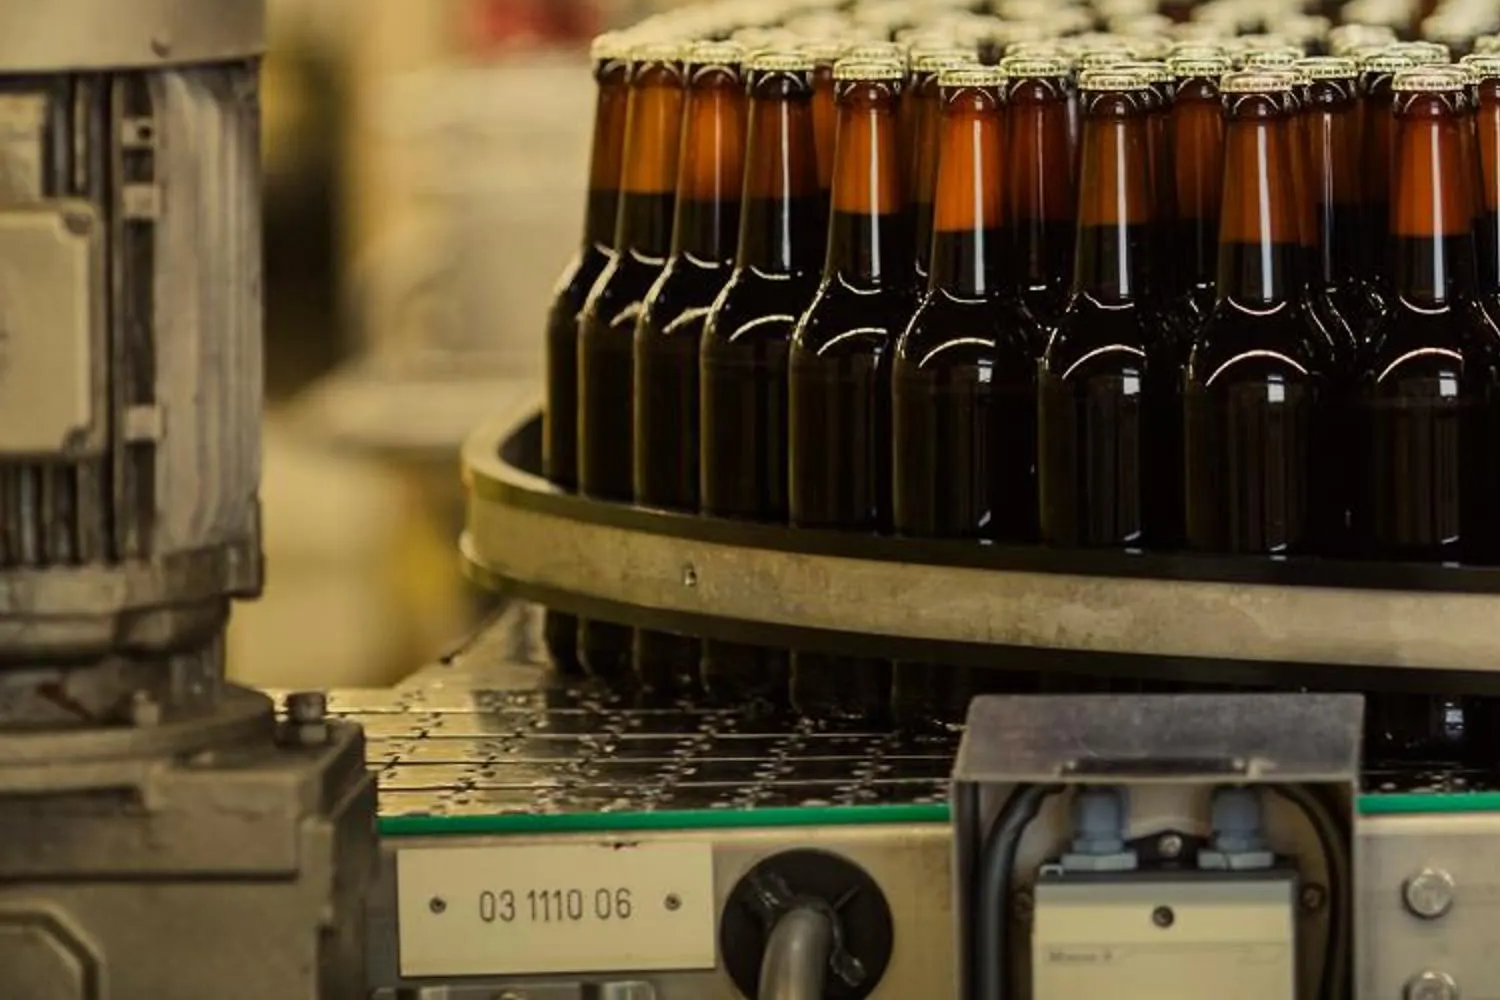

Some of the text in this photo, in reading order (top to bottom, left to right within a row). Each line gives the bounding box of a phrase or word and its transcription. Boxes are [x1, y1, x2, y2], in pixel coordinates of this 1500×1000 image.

[478, 887, 632, 923] 03 1110 06
